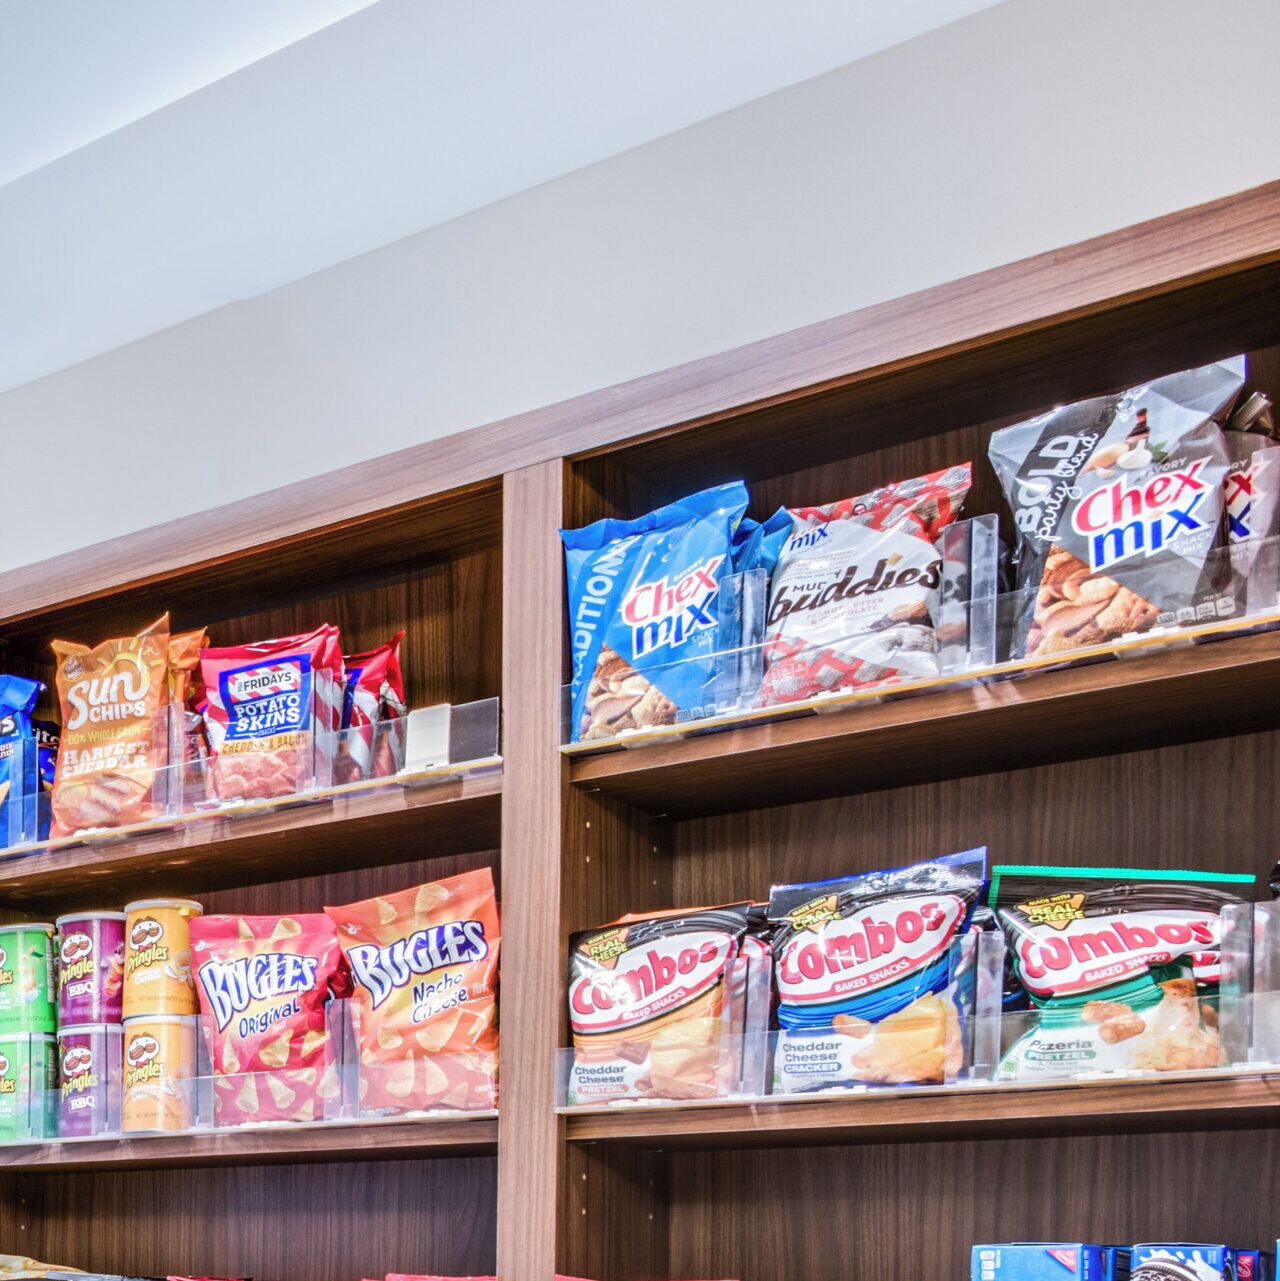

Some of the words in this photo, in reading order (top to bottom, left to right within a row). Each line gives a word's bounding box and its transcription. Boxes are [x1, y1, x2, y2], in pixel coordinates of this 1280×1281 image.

[1076, 461, 1207, 532] Chex
[1093, 491, 1206, 569] mix
[623, 559, 718, 623] Chex
[767, 554, 942, 627] buddies
[243, 671, 292, 691] FRIDAYS
[89, 701, 146, 723] CHIPS
[236, 696, 300, 719] POTATO
[236, 706, 300, 733] SKINS
[1030, 903, 1075, 917] REAL
[781, 901, 946, 984] Combos
[1020, 920, 1215, 979] Combos
[127, 945, 168, 974] Pringles
[347, 921, 489, 1011] BUGLES
[834, 975, 867, 993] BAKED
[868, 959, 911, 982] SNACKS
[199, 953, 317, 1033] BUGLES
[782, 1041, 842, 1052] Cheddar
[784, 1050, 839, 1062] Cheese
[574, 1064, 627, 1075] Cheddar
[578, 1073, 625, 1084] Cheese
[785, 1062, 839, 1073] CRACKER
